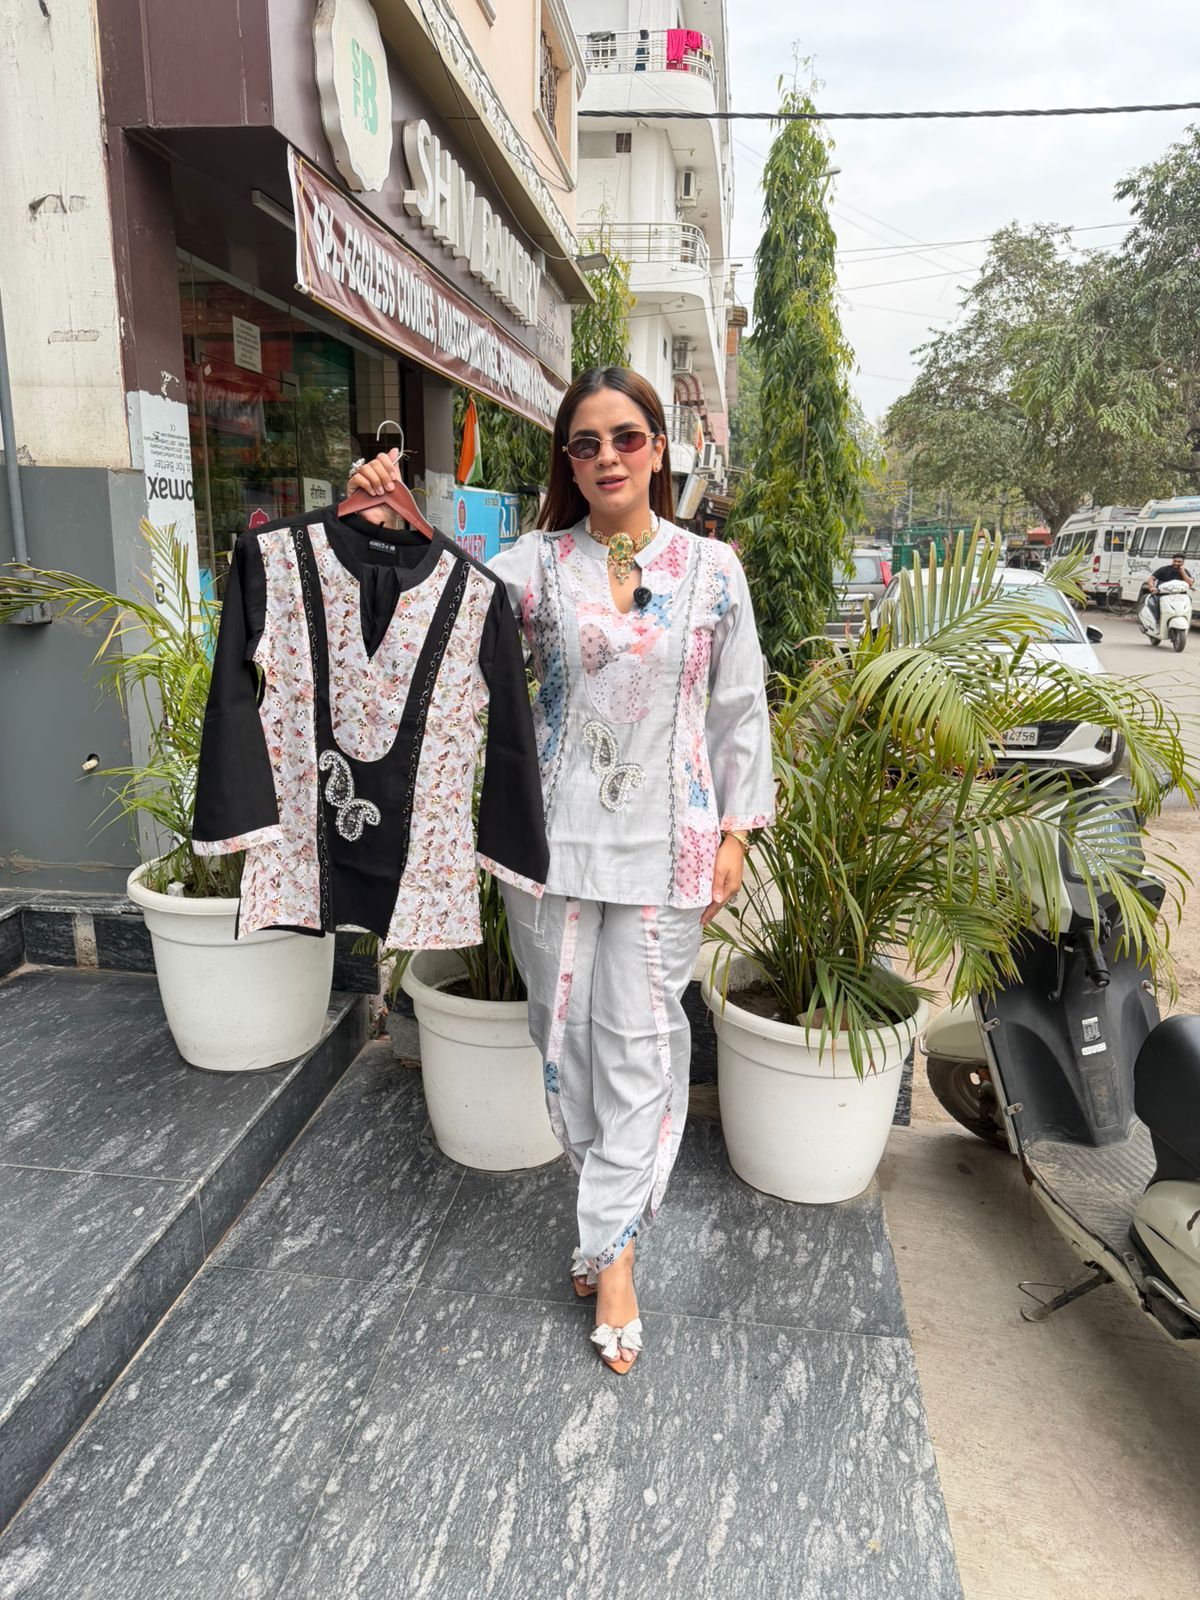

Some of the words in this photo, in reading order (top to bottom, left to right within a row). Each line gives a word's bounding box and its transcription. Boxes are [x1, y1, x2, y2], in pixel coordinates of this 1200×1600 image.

[344, 221, 396, 318] EGGLESS
[403, 118, 476, 260] SHIV
[470, 196, 541, 327] BAKERY
